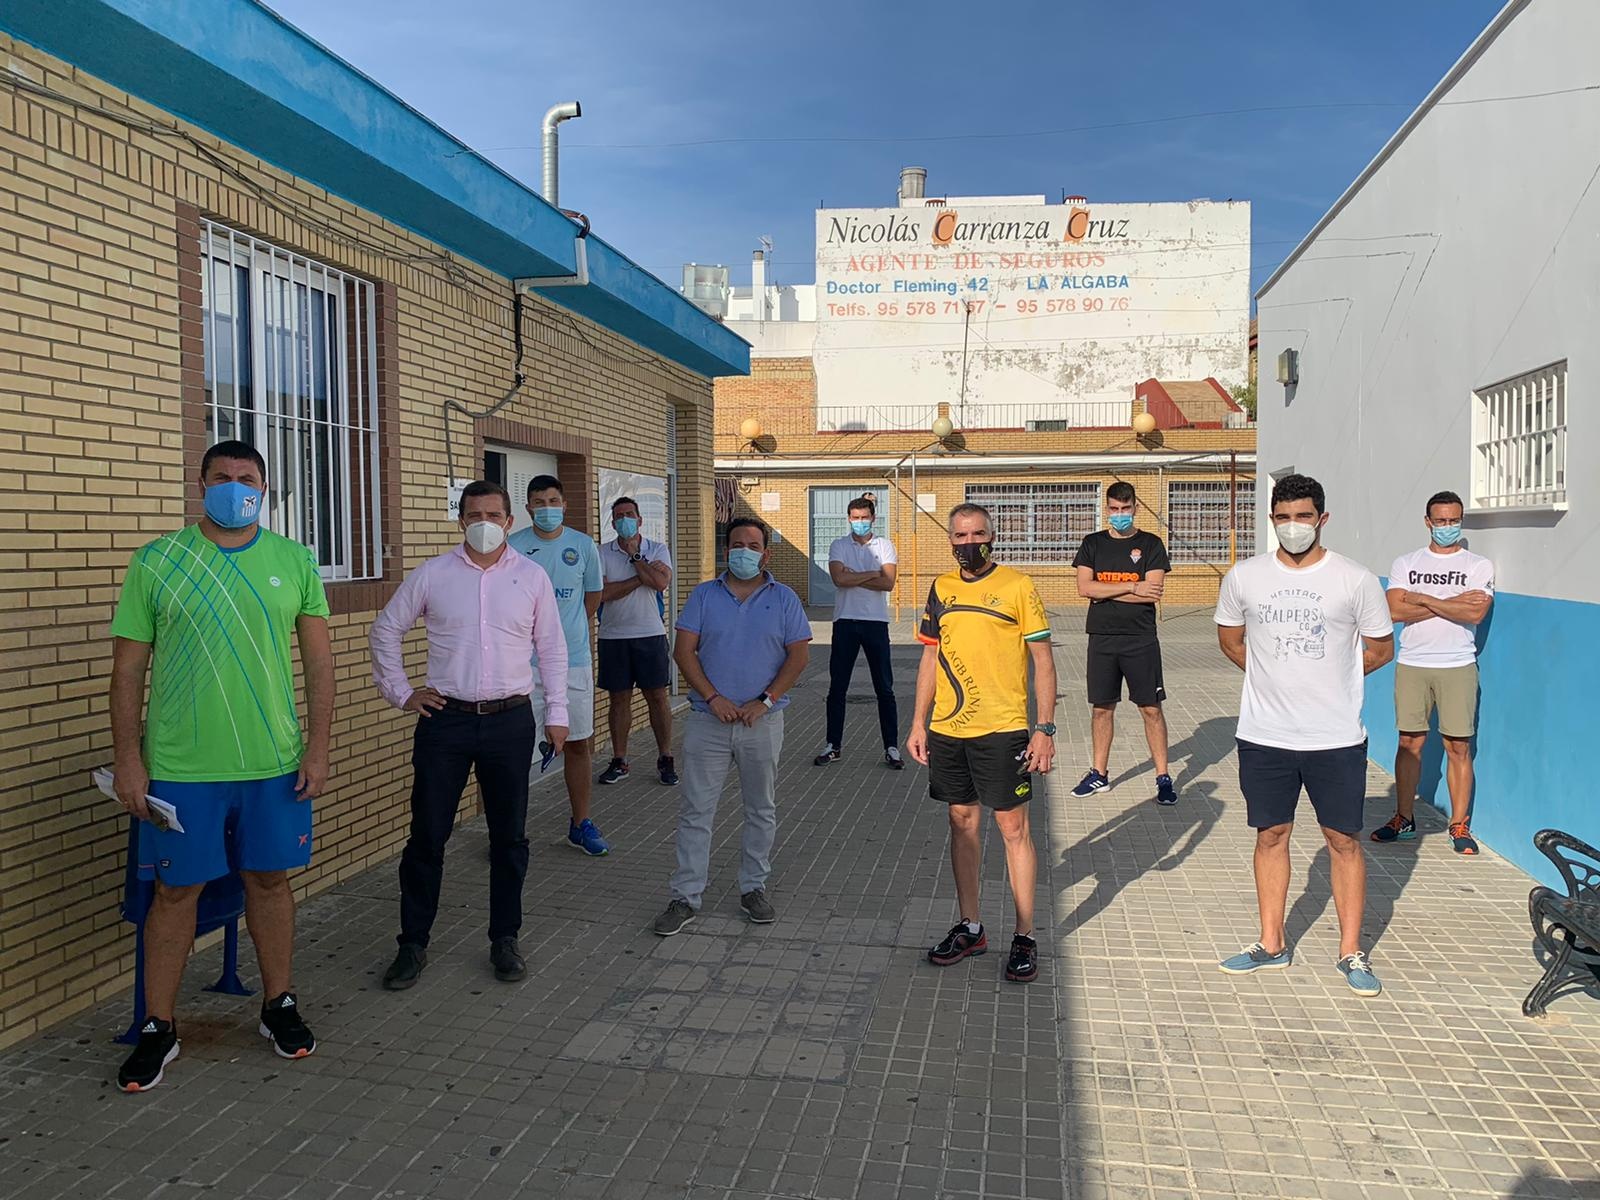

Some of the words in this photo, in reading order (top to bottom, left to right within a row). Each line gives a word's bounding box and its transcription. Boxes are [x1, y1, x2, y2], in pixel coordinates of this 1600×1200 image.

[826, 214, 920, 244] Nicolás
[933, 213, 1050, 242] Carranza
[1065, 211, 1130, 239] Cruz
[847, 253, 937, 272] AGENTE
[953, 252, 984, 270] DE
[999, 251, 1106, 270] SEGUROS
[826, 281, 881, 294] Doctor
[967, 277, 989, 291] 42
[1027, 277, 1049, 290] LA
[1060, 275, 1129, 289] ALGABA
[826, 303, 871, 317] Telfs.
[877, 302, 898, 316] 95
[905, 301, 937, 316] 578
[943, 300, 959, 314] 71
[1016, 299, 1038, 313] 95
[1045, 299, 1076, 312] 578
[1082, 297, 1103, 311] 90
[1109, 297, 1130, 311] 76
[1408, 570, 1468, 587] CrossFit
[555, 588, 574, 598] NET
[1258, 608, 1319, 625] SCALPERS
[947, 650, 967, 676] AGB
